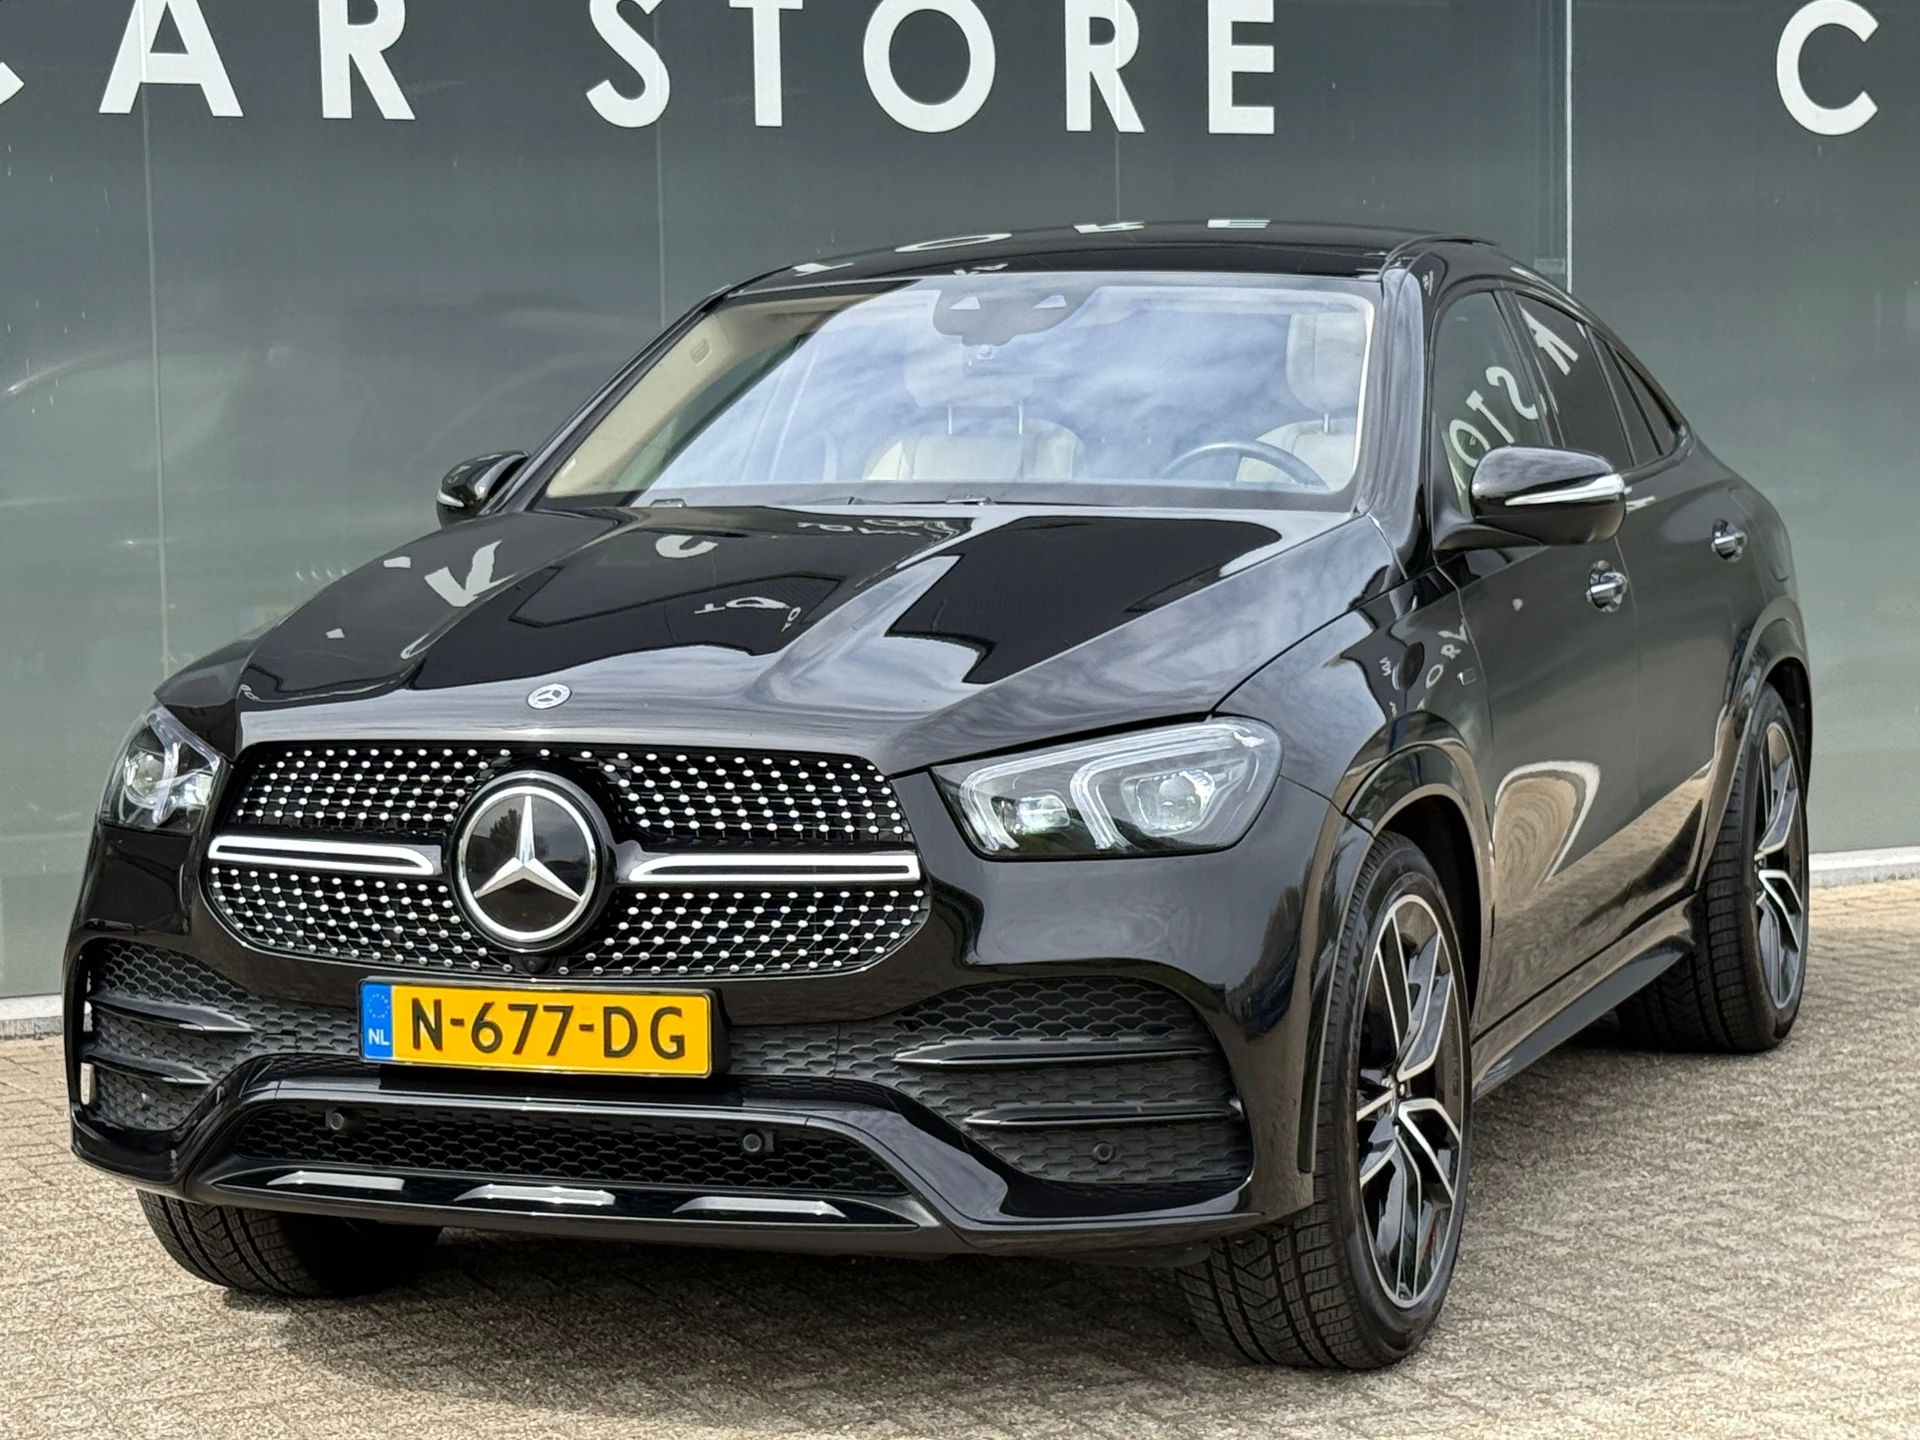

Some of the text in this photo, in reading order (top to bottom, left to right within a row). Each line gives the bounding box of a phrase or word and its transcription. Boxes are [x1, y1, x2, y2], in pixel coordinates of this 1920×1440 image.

[0, 0, 1879, 135] AR STORE C
[368, 1028, 390, 1046] NL
[411, 997, 686, 1060] N-677-DG
